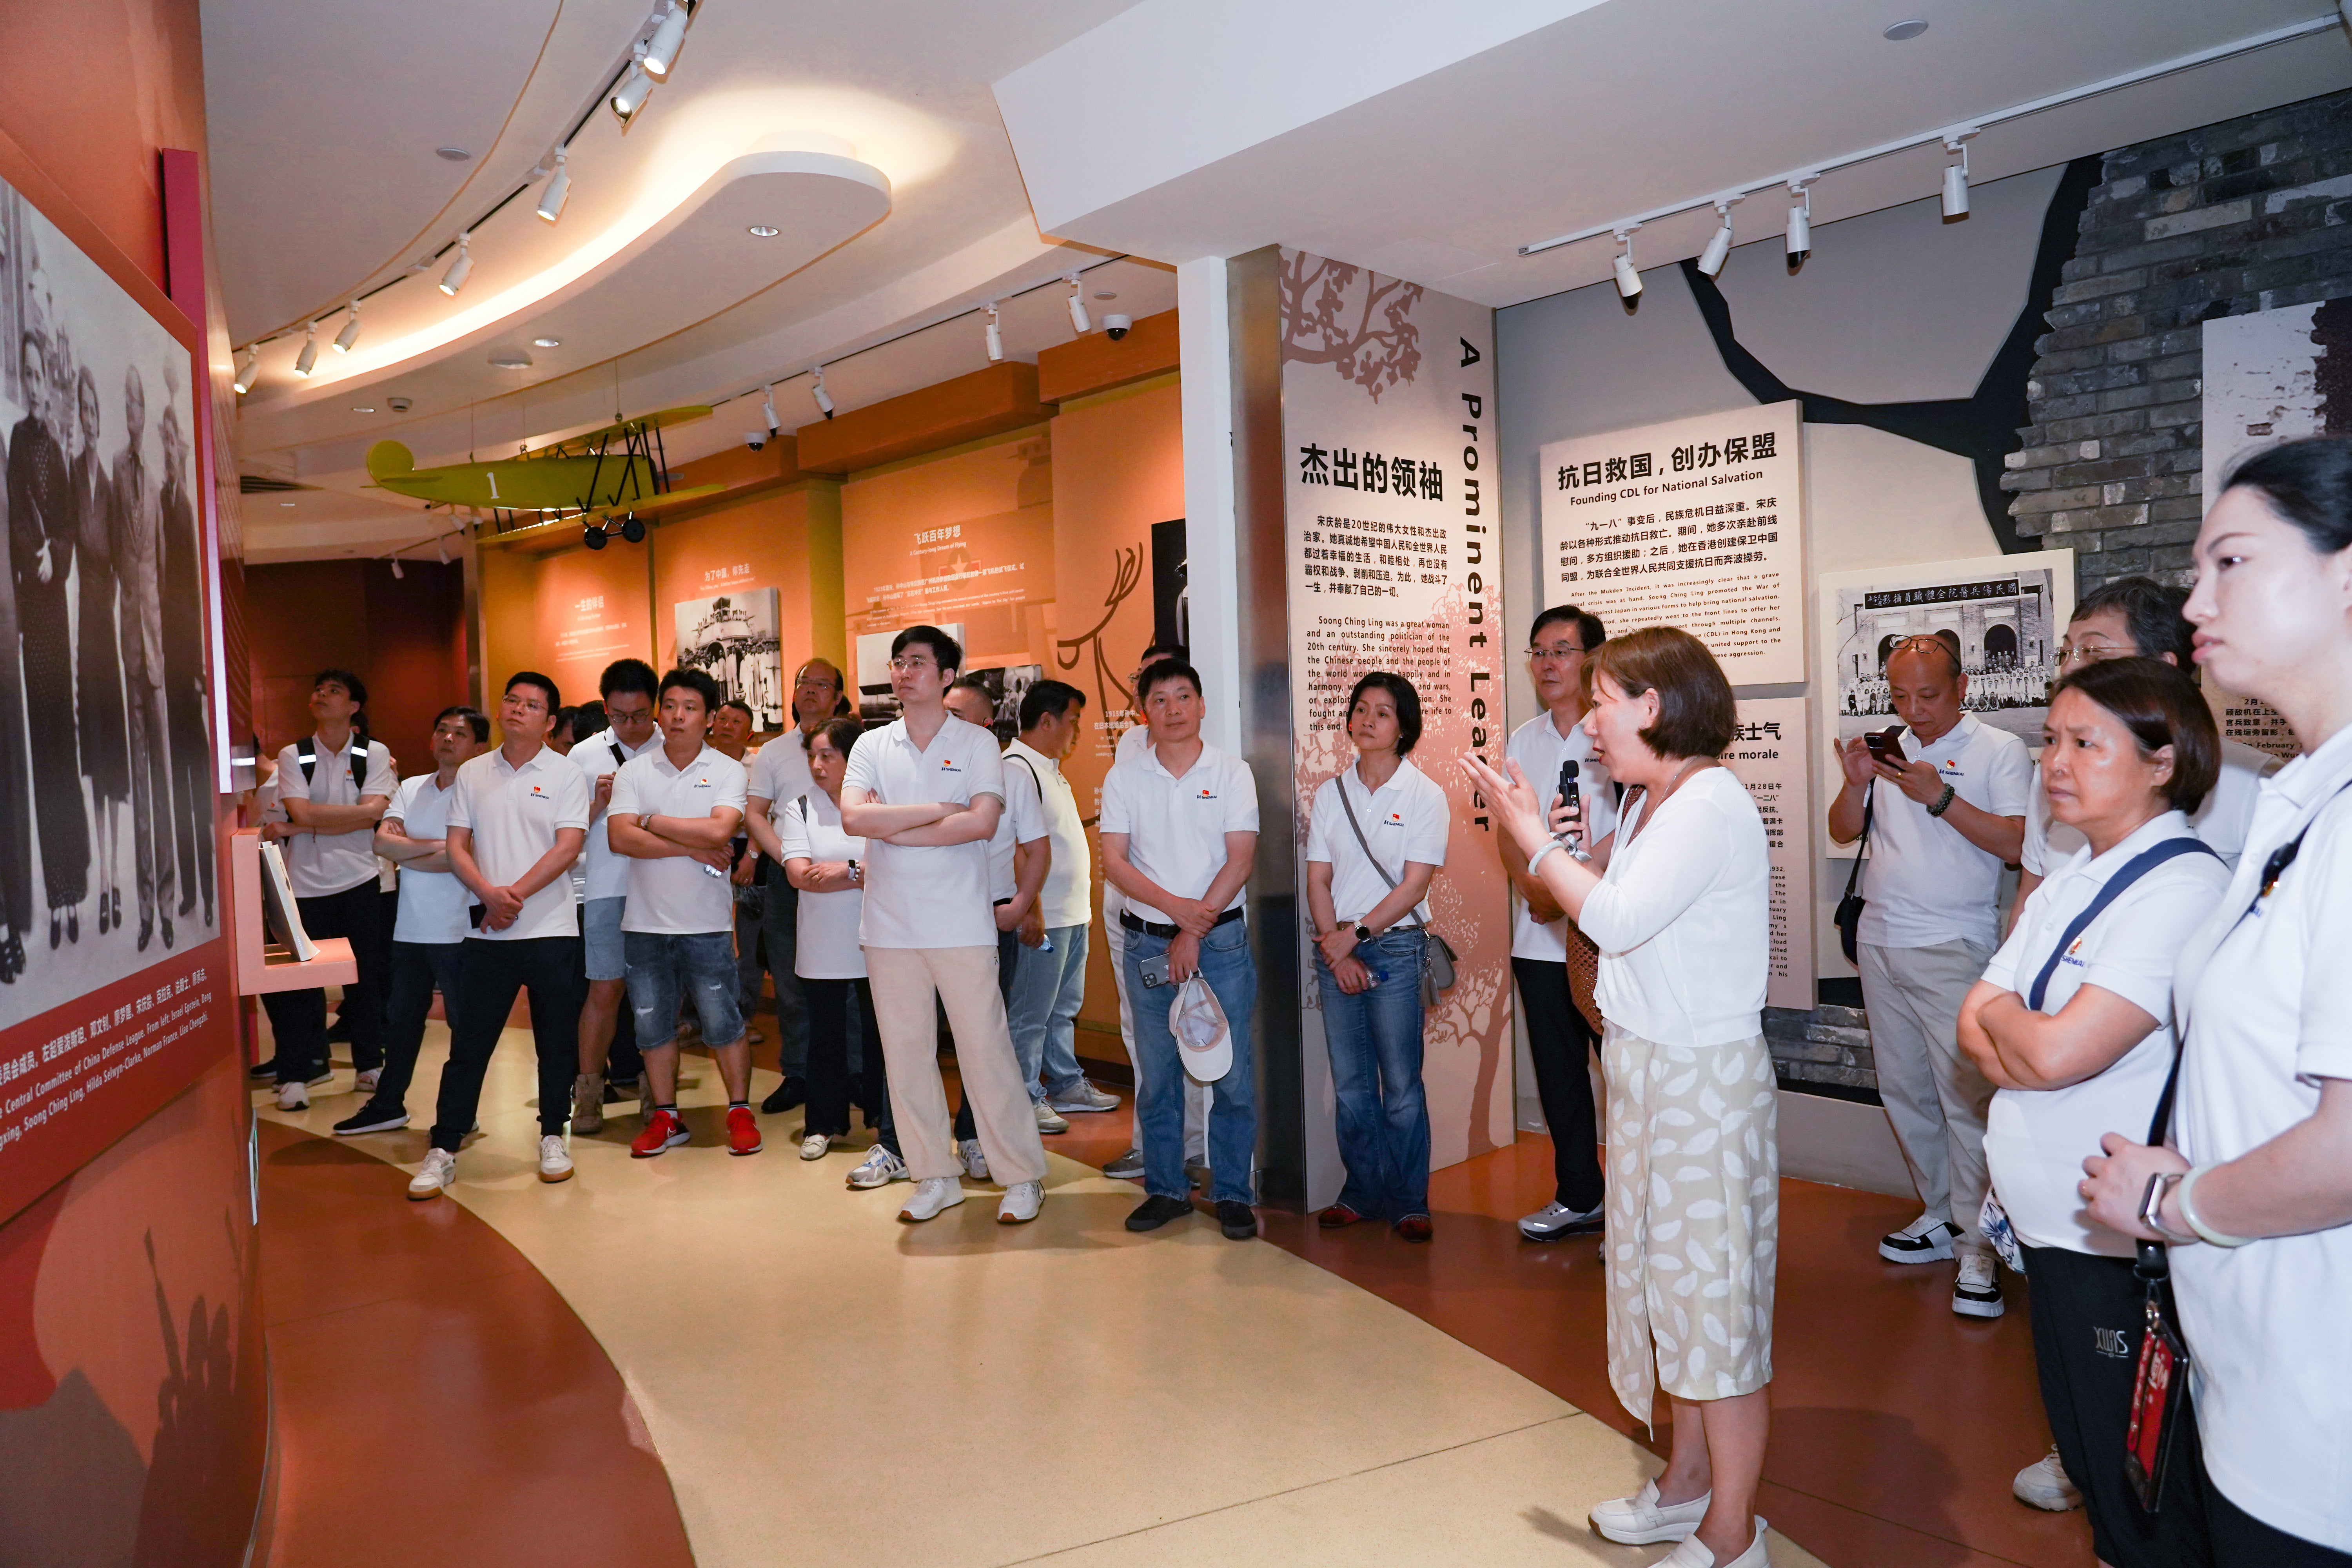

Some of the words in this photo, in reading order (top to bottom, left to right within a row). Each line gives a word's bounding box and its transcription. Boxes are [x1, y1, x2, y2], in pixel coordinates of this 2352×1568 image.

[1460, 336, 1480, 368] A
[1558, 432, 1777, 490] 抗日救国，创办保盟
[1300, 443, 1443, 502] 杰出的领袖
[486, 472, 500, 499] 1
[1571, 492, 1616, 506] Founding
[1620, 488, 1640, 498] CDL
[1643, 485, 1659, 495] for
[1662, 477, 1707, 492] National
[1711, 471, 1762, 485] Salvation
[1317, 515, 1446, 539] 宋庆龄是20世纪的伟大女性和杰出政
[1462, 393, 1488, 649] Prominent
[913, 524, 961, 544] 飞跃百年梦想
[1560, 514, 1777, 551] 龄以各种形式推动抗日救亡。期间，她多次亲赴前线
[1303, 530, 1447, 554] 治家。她真诚地希望中国人民和全世界人民
[1304, 547, 1447, 570] 都过着幸福的生活，和睦相处，再也没有
[1305, 582, 1399, 597] 一生，并奉献了自己的一切。
[1708, 586, 1737, 595] promoted
[1319, 616, 1342, 627] Soong
[1345, 617, 1365, 628] Ching
[1368, 618, 1383, 629] Ling
[1406, 621, 1424, 630] great
[1341, 631, 1385, 641] outstanding
[1390, 632, 1422, 642] politician
[1439, 633, 1450, 641] the
[1307, 642, 1324, 651] 20th
[1328, 644, 1358, 654] century.
[1362, 643, 1375, 652] She
[1379, 644, 1409, 655] sincerely
[1413, 644, 1433, 655] hoped
[1437, 645, 1450, 653] that
[1307, 655, 1320, 664] the
[1325, 655, 1354, 664] Chinese
[1358, 656, 1382, 667] people
[1403, 657, 1414, 665] the
[1418, 657, 1440, 668] people
[1444, 657, 1450, 666] of
[1308, 669, 1320, 677] the
[1326, 669, 1347, 678] world
[1396, 670, 1423, 680] happily
[1308, 682, 1343, 693] harmony,
[1309, 708, 1335, 719] fought
[1431, 706, 1442, 715] life
[1310, 722, 1324, 731] this
[1327, 722, 1343, 730] end.
[1739, 749, 1779, 759] morale
[5, 1087, 33, 1114] Central
[35, 1069, 72, 1097] Committee
[74, 1060, 81, 1075] of
[83, 1053, 100, 1070] China
[102, 1040, 124, 1060] Defense
[147, 1021, 159, 1034] From
[171, 1005, 183, 1021] Israel
[201, 992, 211, 1004] Deng
[24, 1109, 47, 1131] Soong
[48, 1097, 68, 1116] Ching
[69, 1088, 85, 1103] Ling,
[87, 1074, 102, 1093] Hilda
[143, 1041, 162, 1058] Norman
[163, 1031, 179, 1046] France,
